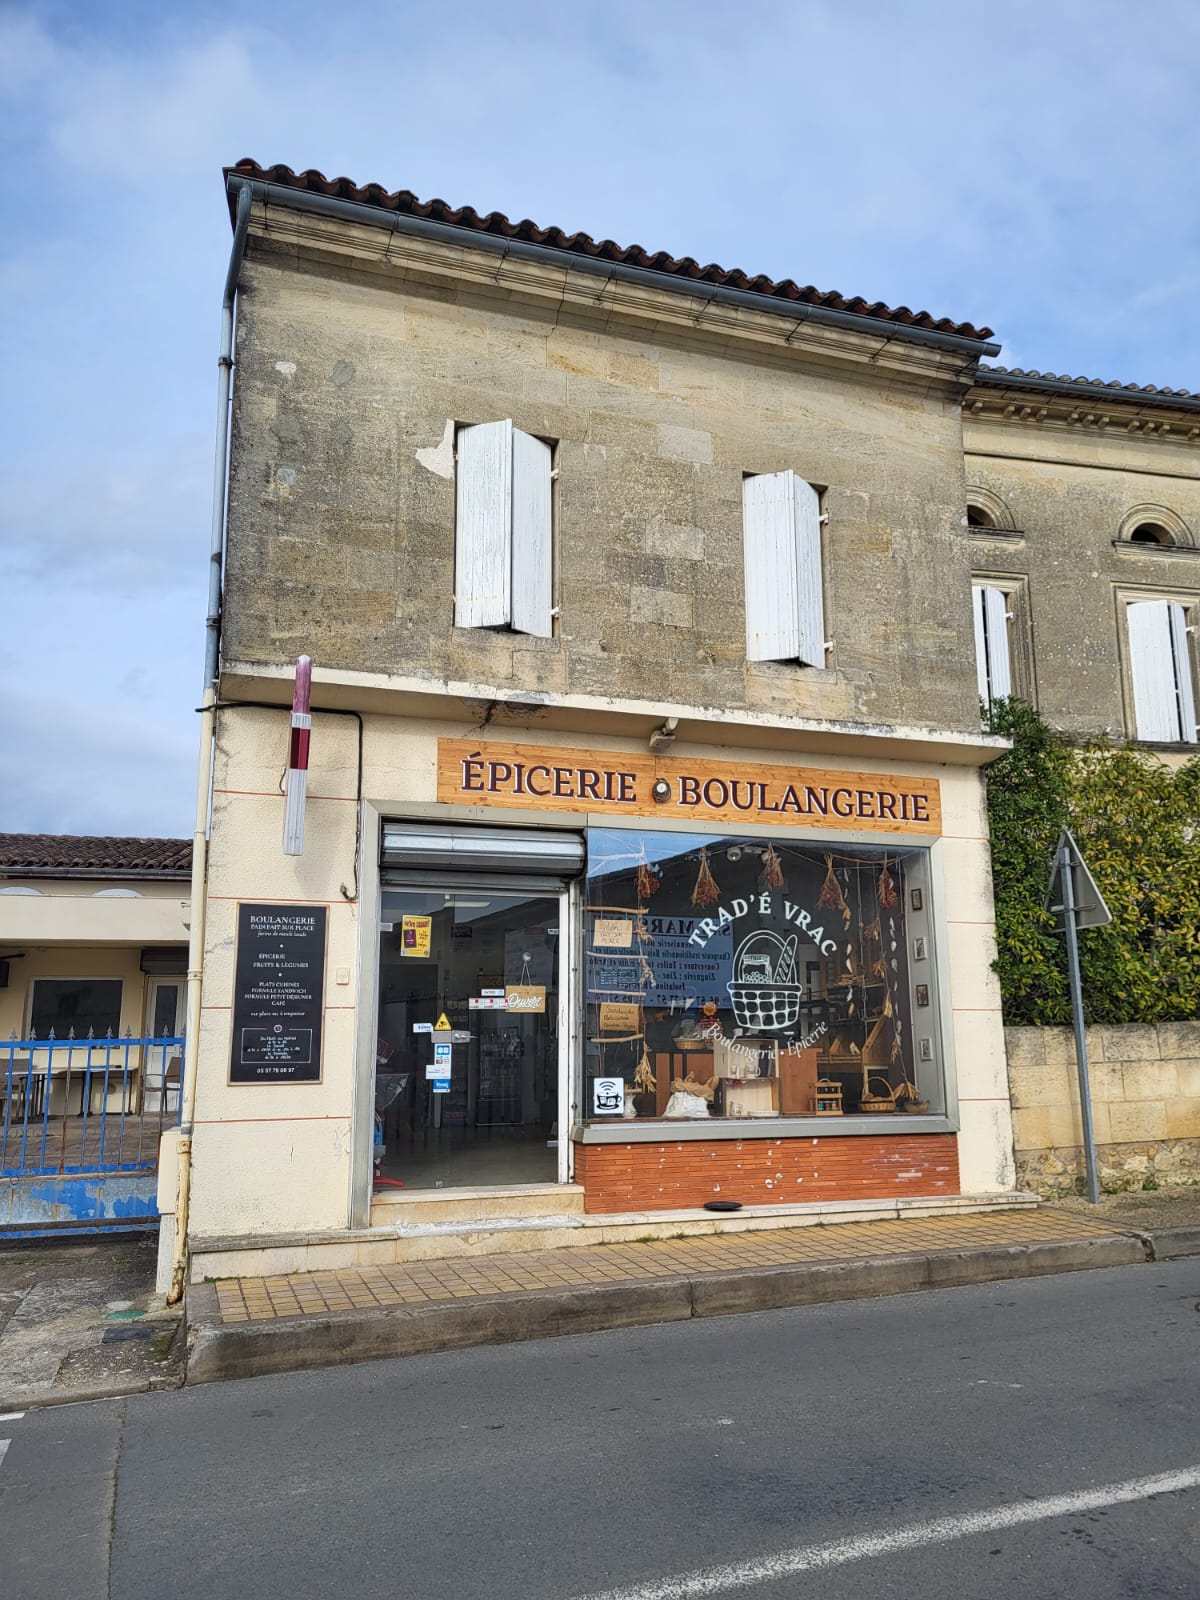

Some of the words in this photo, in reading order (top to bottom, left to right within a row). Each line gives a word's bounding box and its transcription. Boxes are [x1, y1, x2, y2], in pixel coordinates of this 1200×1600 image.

[461, 751, 637, 803] ÉPICERIE
[677, 775, 930, 822] BOULANGERIE
[250, 915, 316, 925] BOULANGERIE
[783, 900, 837, 957] VRAC
[508, 993, 542, 1008] Ouvert
[706, 1022, 777, 1061] Boulangerie
[787, 1021, 829, 1058] Épicerie
